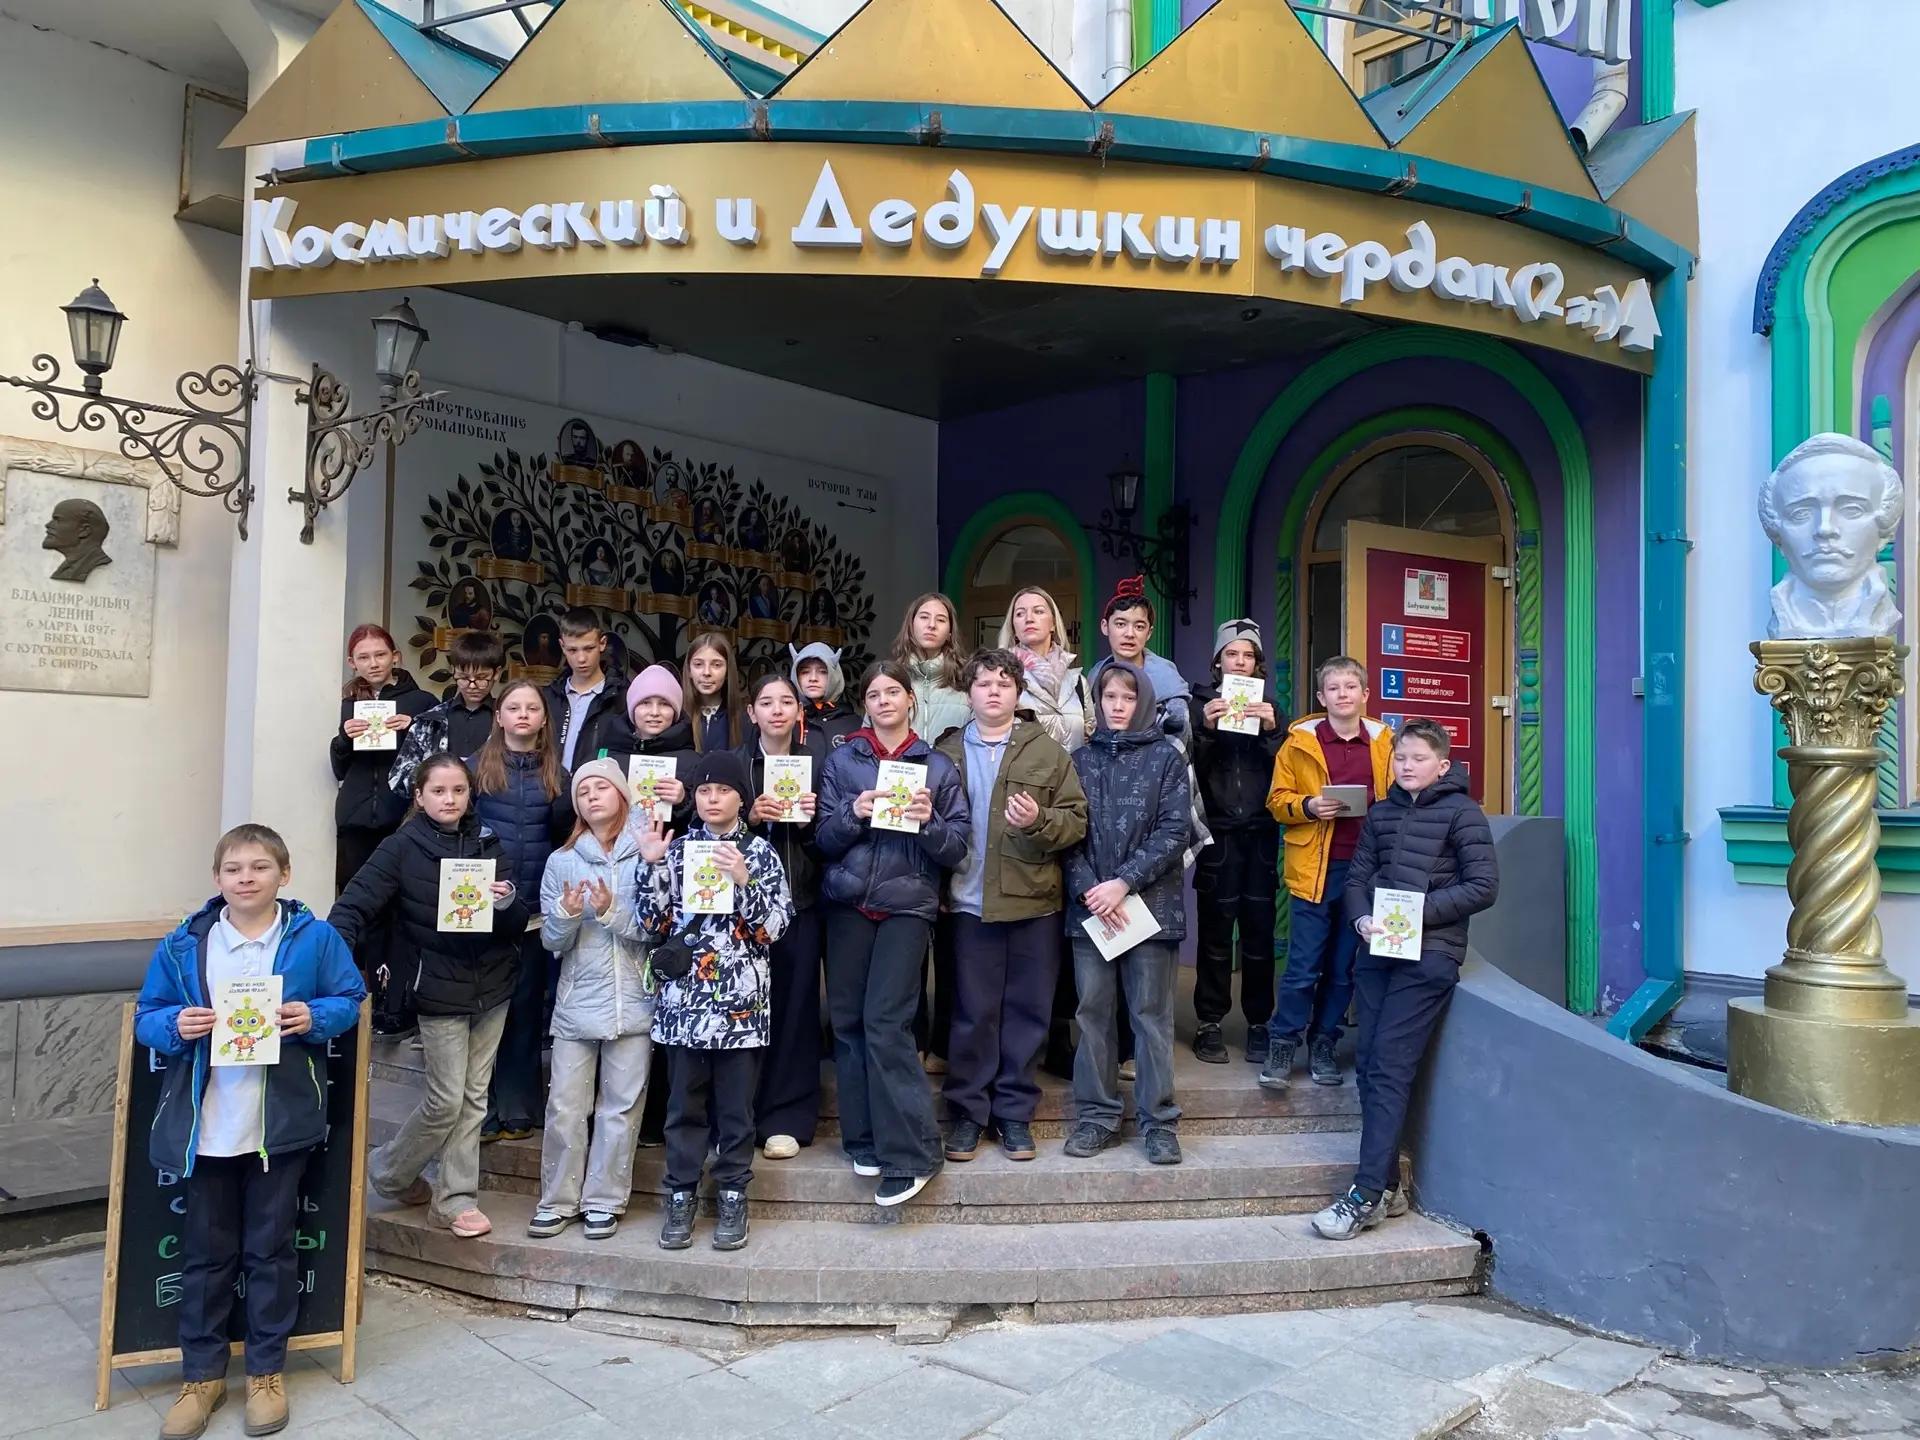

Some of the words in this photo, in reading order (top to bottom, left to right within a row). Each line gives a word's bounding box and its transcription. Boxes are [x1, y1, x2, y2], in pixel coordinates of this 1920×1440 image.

[248, 184, 690, 272] Космический
[715, 197, 761, 247] и
[790, 158, 1241, 275] Дедушкин
[1264, 220, 1517, 310] чердак
[48, 607, 94, 621] ЛЕНИН
[26, 619, 34, 628] 6
[39, 620, 79, 633] МАРТА
[44, 633, 97, 646] ВЫЕХАЛ
[1390, 629, 1397, 642] 4
[4, 643, 14, 652] С
[17, 643, 78, 657] КУРСКОГО
[82, 649, 133, 661] ВОКЗАЛА
[38, 658, 47, 667] В
[51, 658, 98, 671] СИБИРЬ
[1390, 674, 1397, 686] 3
[1407, 676, 1420, 685] КЛУБ
[1407, 686, 1440, 696] СПОРТИВНЫЙ
[1440, 689, 1455, 697] ПОКЕР
[1390, 718, 1396, 730] 2
